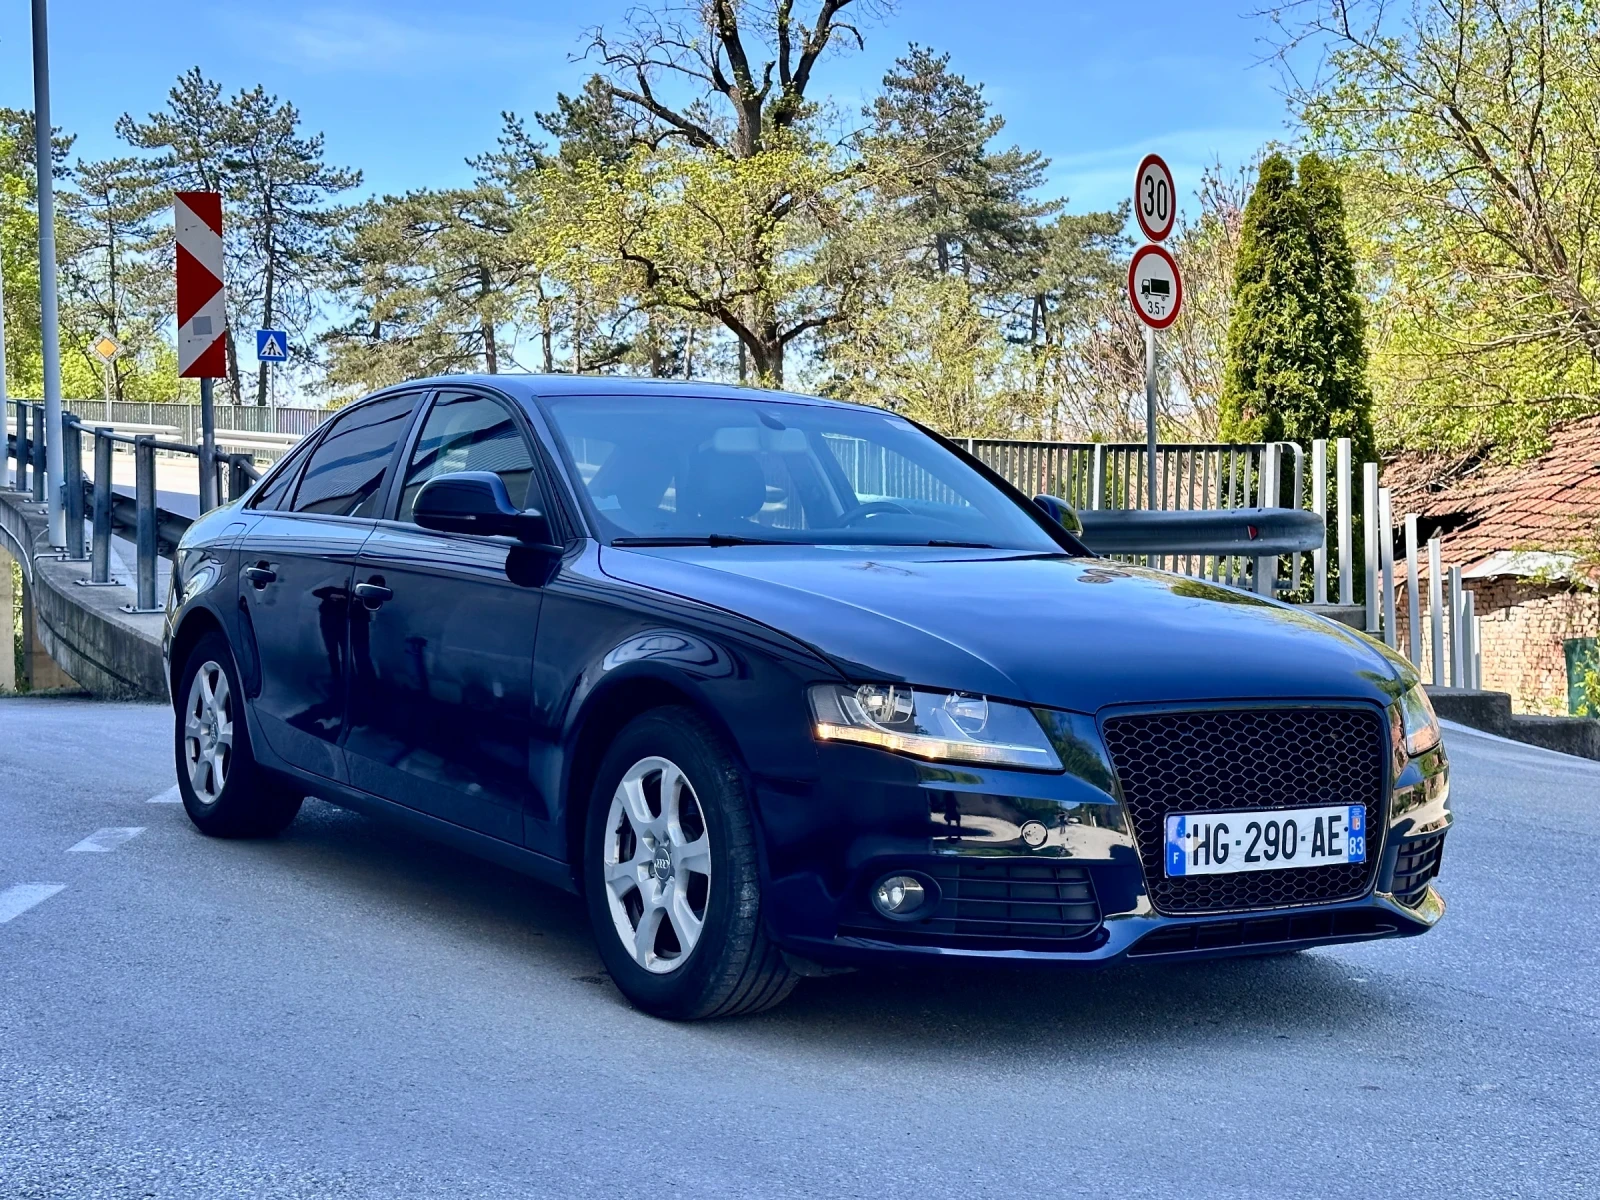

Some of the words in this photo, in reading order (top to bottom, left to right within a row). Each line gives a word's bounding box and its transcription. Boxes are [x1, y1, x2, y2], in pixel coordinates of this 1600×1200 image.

[1144, 174, 1167, 221] 30
[1349, 836, 1364, 856] 83
[1173, 852, 1179, 865] F
